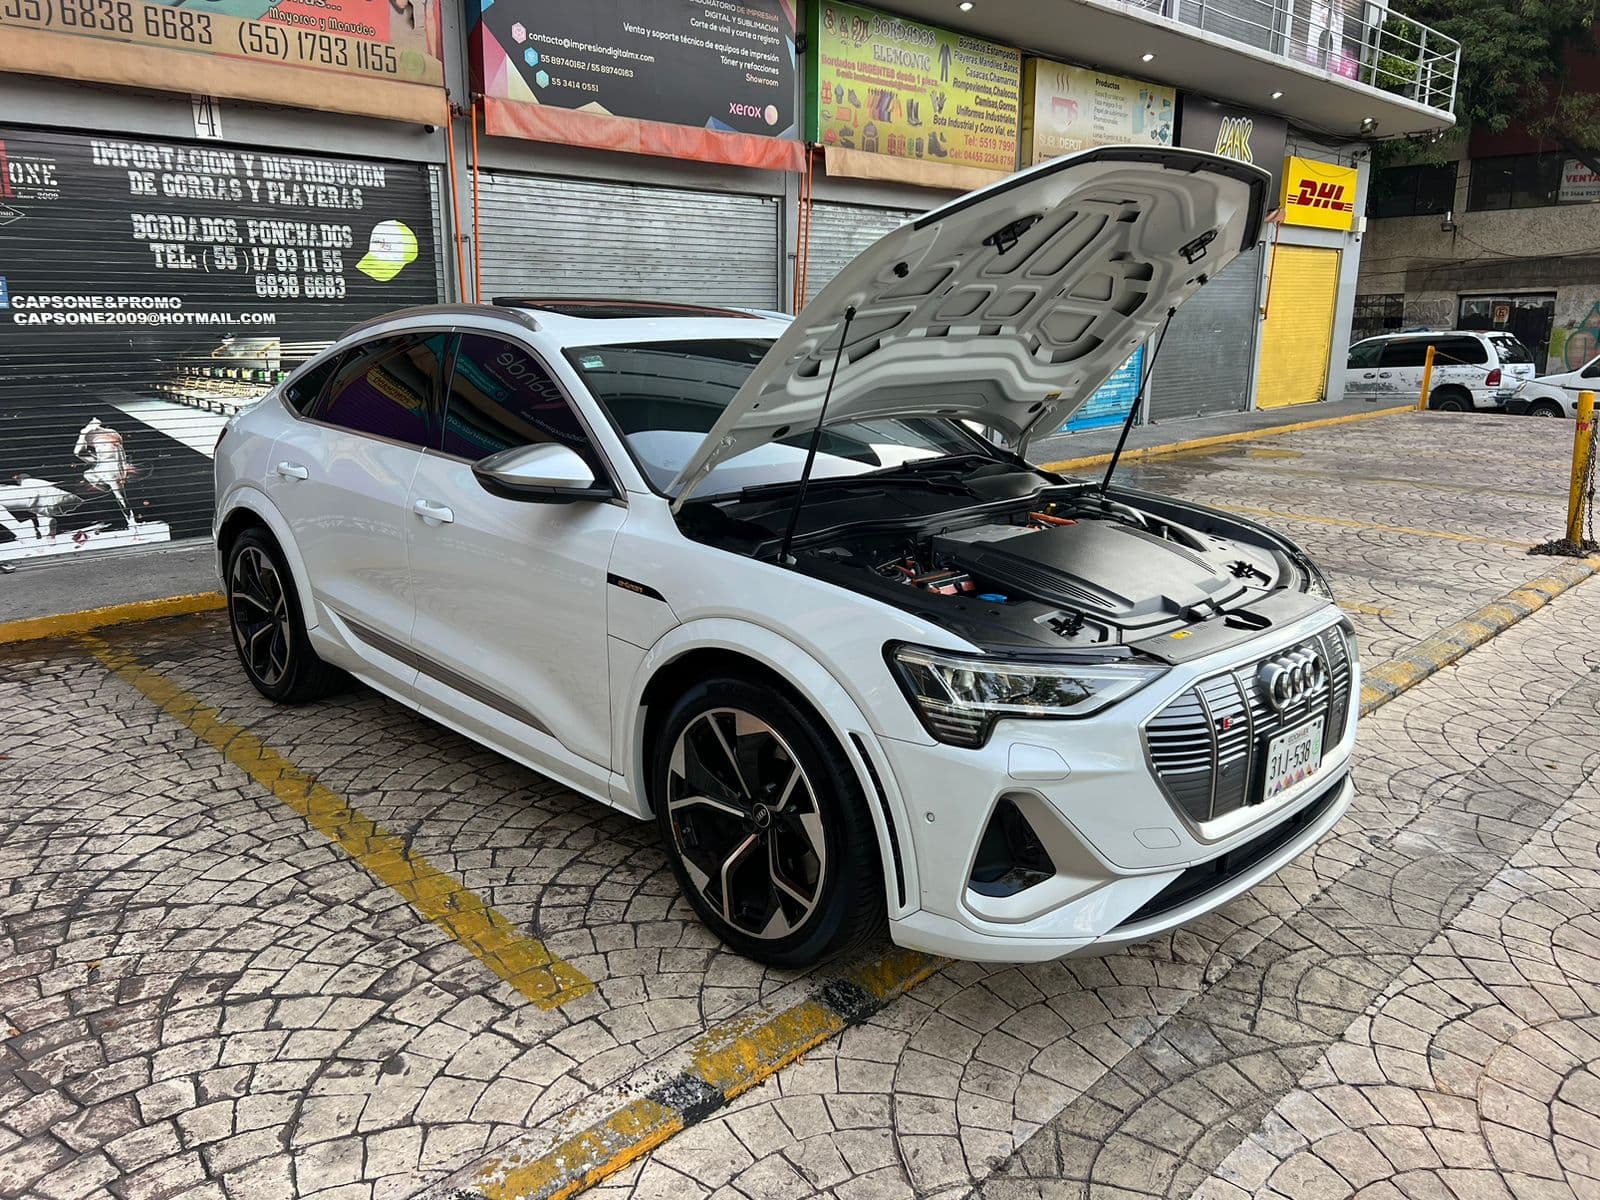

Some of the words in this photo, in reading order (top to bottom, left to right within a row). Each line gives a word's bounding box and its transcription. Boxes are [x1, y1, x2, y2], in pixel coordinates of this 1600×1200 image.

[705, 9, 731, 23] DIGITAL
[732, 16, 737, 24] Y
[736, 5, 744, 14] DE
[144, 6, 212, 45] 6683
[320, 18, 326, 32] y
[328, 18, 376, 37] Menudeo
[690, 17, 708, 30] Corte
[709, 22, 718, 32] de
[736, 30, 752, 40] corte
[757, 35, 780, 45] registro
[238, 21, 288, 60] (55)
[298, 31, 347, 67] 1793
[356, 41, 397, 73] 1155
[623, 21, 646, 35] Venta
[646, 28, 651, 37] y
[652, 29, 680, 43] soporte
[680, 34, 704, 47] técnico
[705, 39, 714, 49] de
[714, 42, 739, 55] equipos
[740, 46, 749, 56] de
[541, 54, 550, 63] 55
[591, 63, 600, 72] 55
[720, 55, 739, 67] Tóner
[744, 61, 779, 76] refacciones
[551, 77, 561, 86] 55
[562, 79, 581, 89] 3414
[745, 73, 779, 87] Showroom
[1096, 78, 1120, 91] Productos
[198, 95, 217, 137] 4
[729, 101, 762, 119] xerox
[933, 114, 947, 126] Bota
[948, 117, 974, 132] Industrial
[964, 134, 978, 148] Tel:
[9, 162, 58, 186] ONE
[90, 140, 237, 176] IMPORTACION
[242, 154, 254, 178] Y
[262, 156, 387, 188] DISTRIBUCION
[128, 170, 158, 197] DE
[162, 173, 244, 202] GORRAS
[247, 180, 261, 202] Y
[268, 181, 364, 210] PLAYERAS
[1297, 179, 1345, 211] DHL
[248, 220, 354, 249] PONCHADOS
[275, 249, 298, 273] 93
[303, 250, 318, 273] 11
[322, 250, 343, 274] 55
[255, 275, 300, 298] 6838
[304, 275, 347, 299] 6683
[11, 295, 182, 310] CAPSONE&PROMO
[13, 312, 277, 326] CAPSONE2009@HOTMAIL.COM
[1269, 739, 1311, 781] 31J-538
